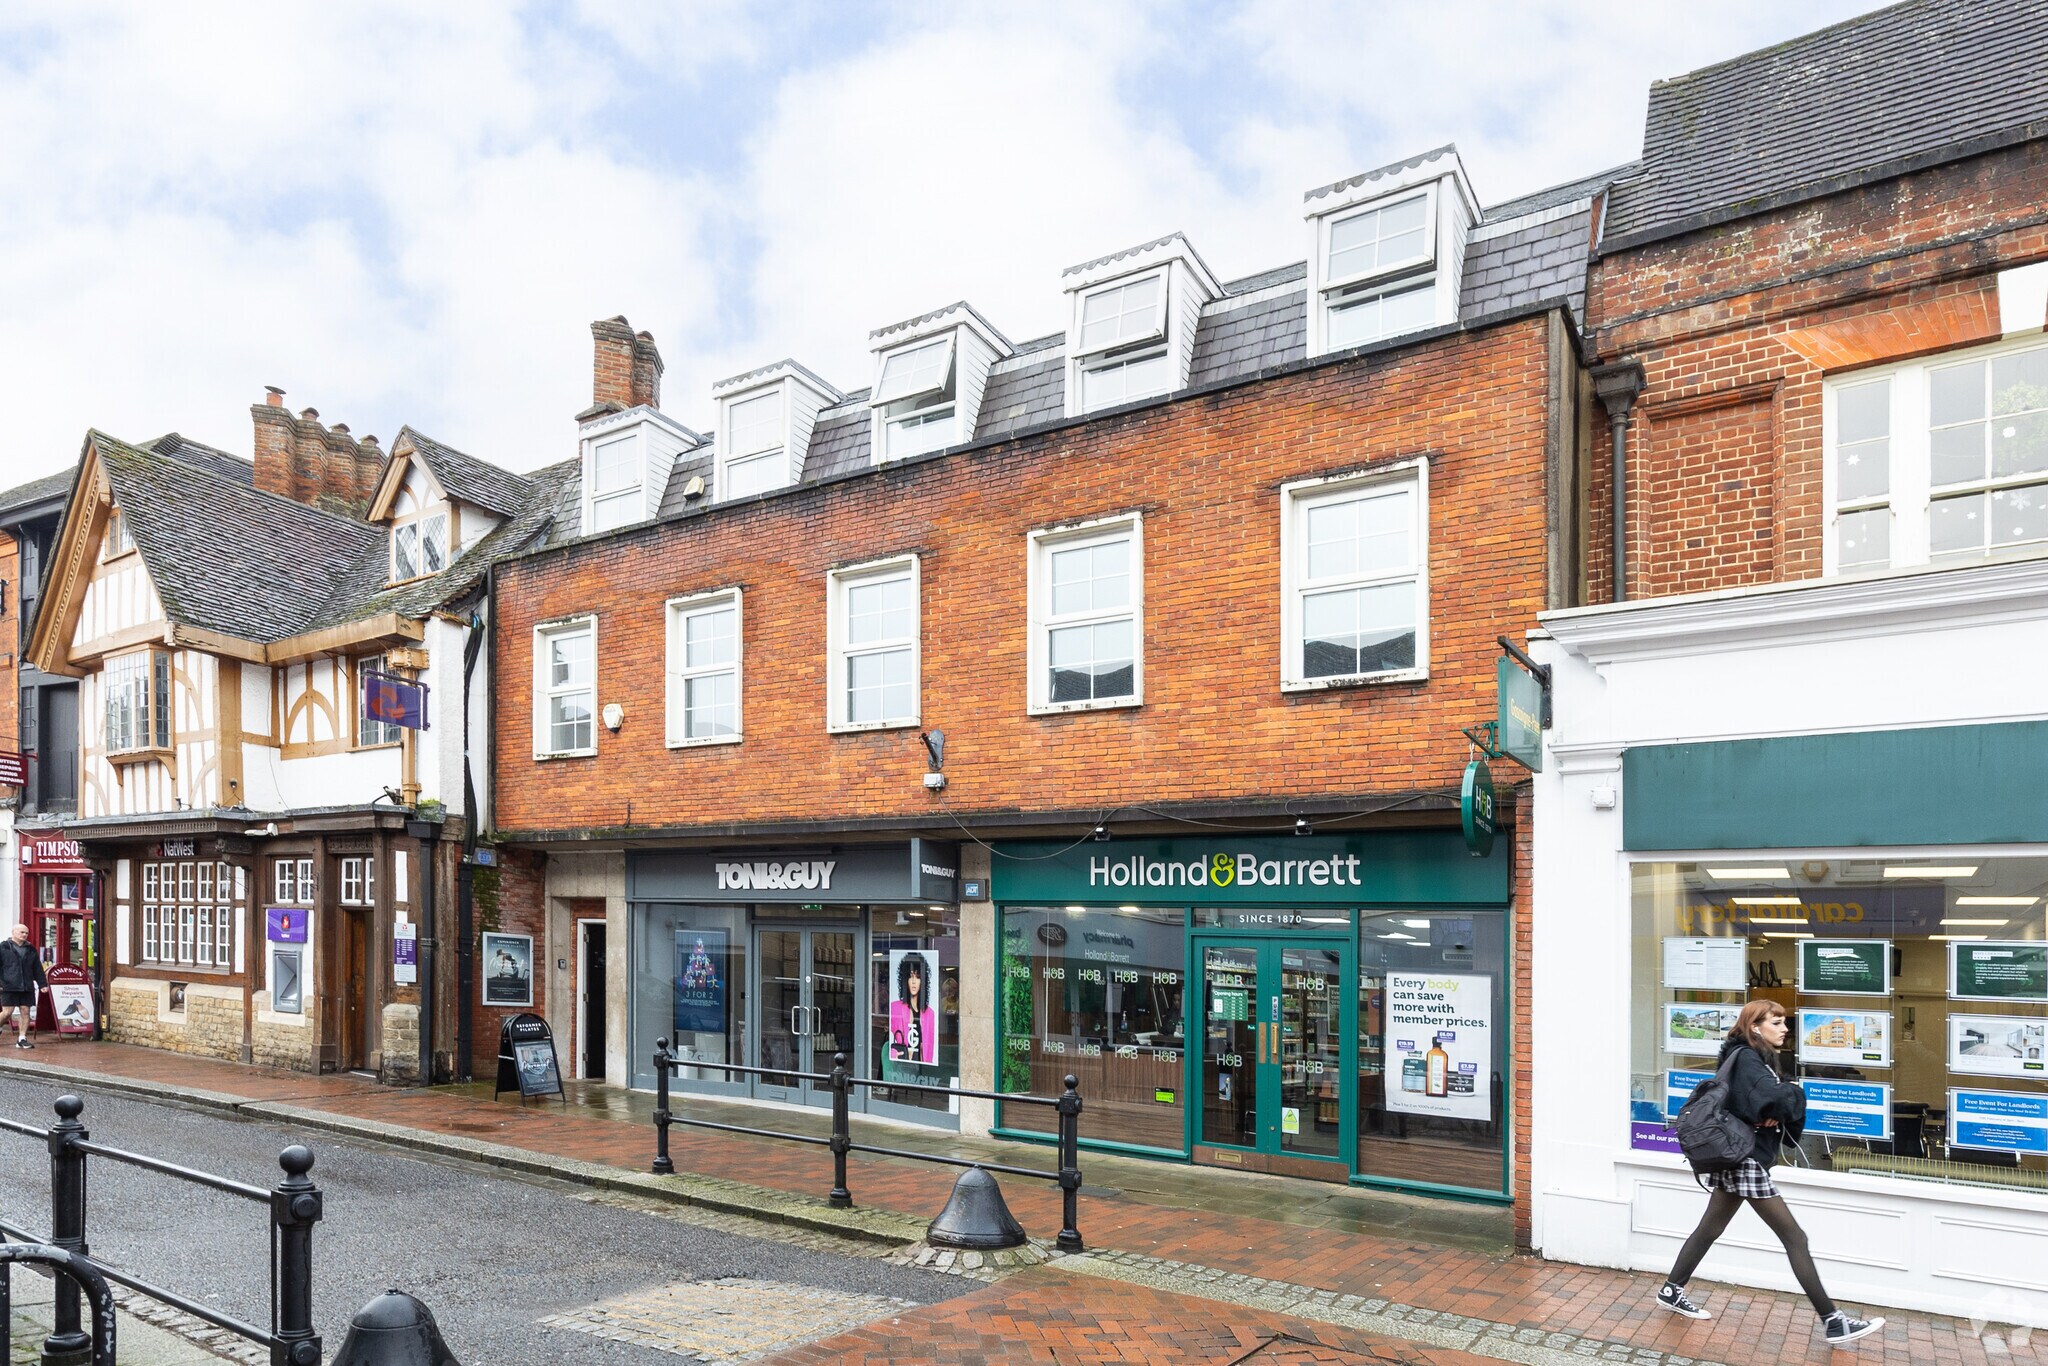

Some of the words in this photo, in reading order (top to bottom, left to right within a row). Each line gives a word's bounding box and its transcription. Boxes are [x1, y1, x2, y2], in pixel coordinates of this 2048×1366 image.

[36, 841, 80, 857] TIMPSO
[164, 842, 195, 857] NatWest
[716, 861, 836, 890] TONI&GUY
[921, 863, 956, 879] TONI&GUY
[965, 884, 978, 896] ADT
[1239, 914, 1273, 924] SINCE
[1277, 914, 1302, 924] 1870
[1009, 967, 1030, 978] H&B
[1043, 967, 1065, 979] H&B
[1078, 969, 1101, 981] H&B
[1115, 970, 1138, 983] H&B
[1153, 972, 1177, 985] H&B
[1296, 977, 1324, 990] H&B
[1393, 977, 1426, 990] Every
[1428, 979, 1459, 992] body
[692, 991, 707, 999] FOR
[1393, 991, 1415, 1000] can
[1417, 992, 1444, 1001] save
[1393, 1003, 1424, 1012] more
[1426, 1003, 1455, 1013] with
[1393, 1015, 1444, 1025] member
[1446, 1016, 1487, 1028] prices.
[1009, 1039, 1030, 1051] H&B
[1153, 1050, 1177, 1063] H&B
[1216, 1053, 1242, 1067] H&B
[1296, 1060, 1324, 1074] H&B
[1848, 1090, 1877, 1098] Landlords
[1636, 1132, 1647, 1140] See
